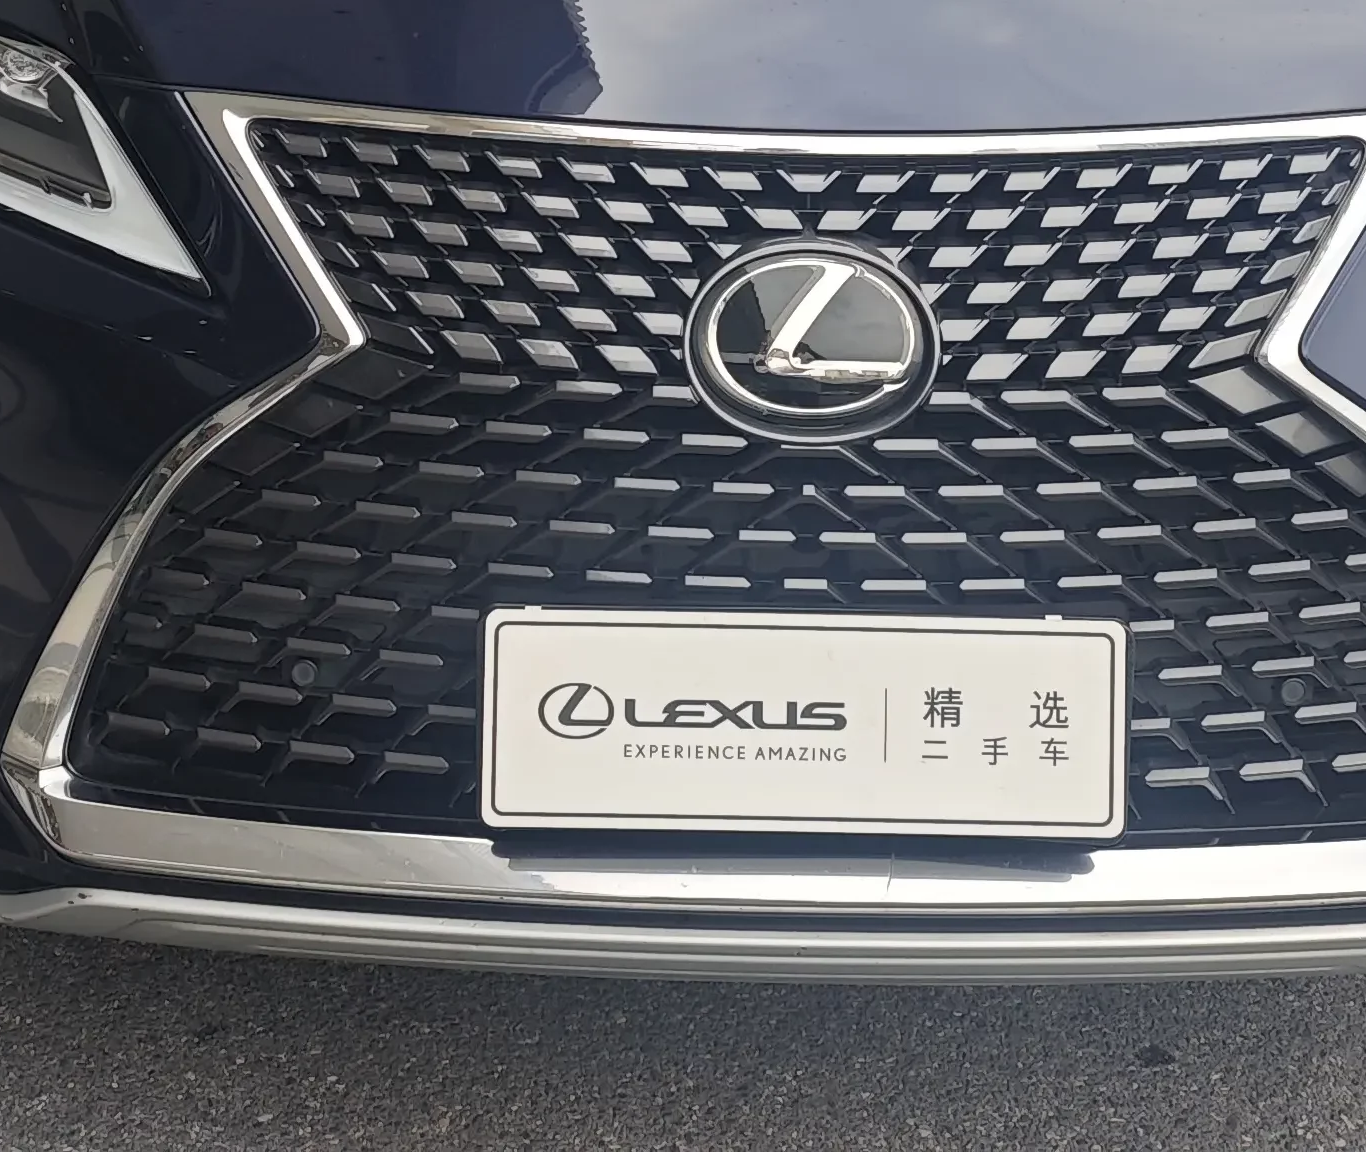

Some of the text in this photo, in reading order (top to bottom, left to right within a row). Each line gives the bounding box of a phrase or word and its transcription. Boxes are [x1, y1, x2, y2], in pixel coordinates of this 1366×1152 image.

[624, 698, 848, 731] LEXUS
[922, 686, 1070, 729] 精选
[623, 743, 848, 762] EXPERIENCE AMAZING
[921, 736, 1070, 767] 二手车
